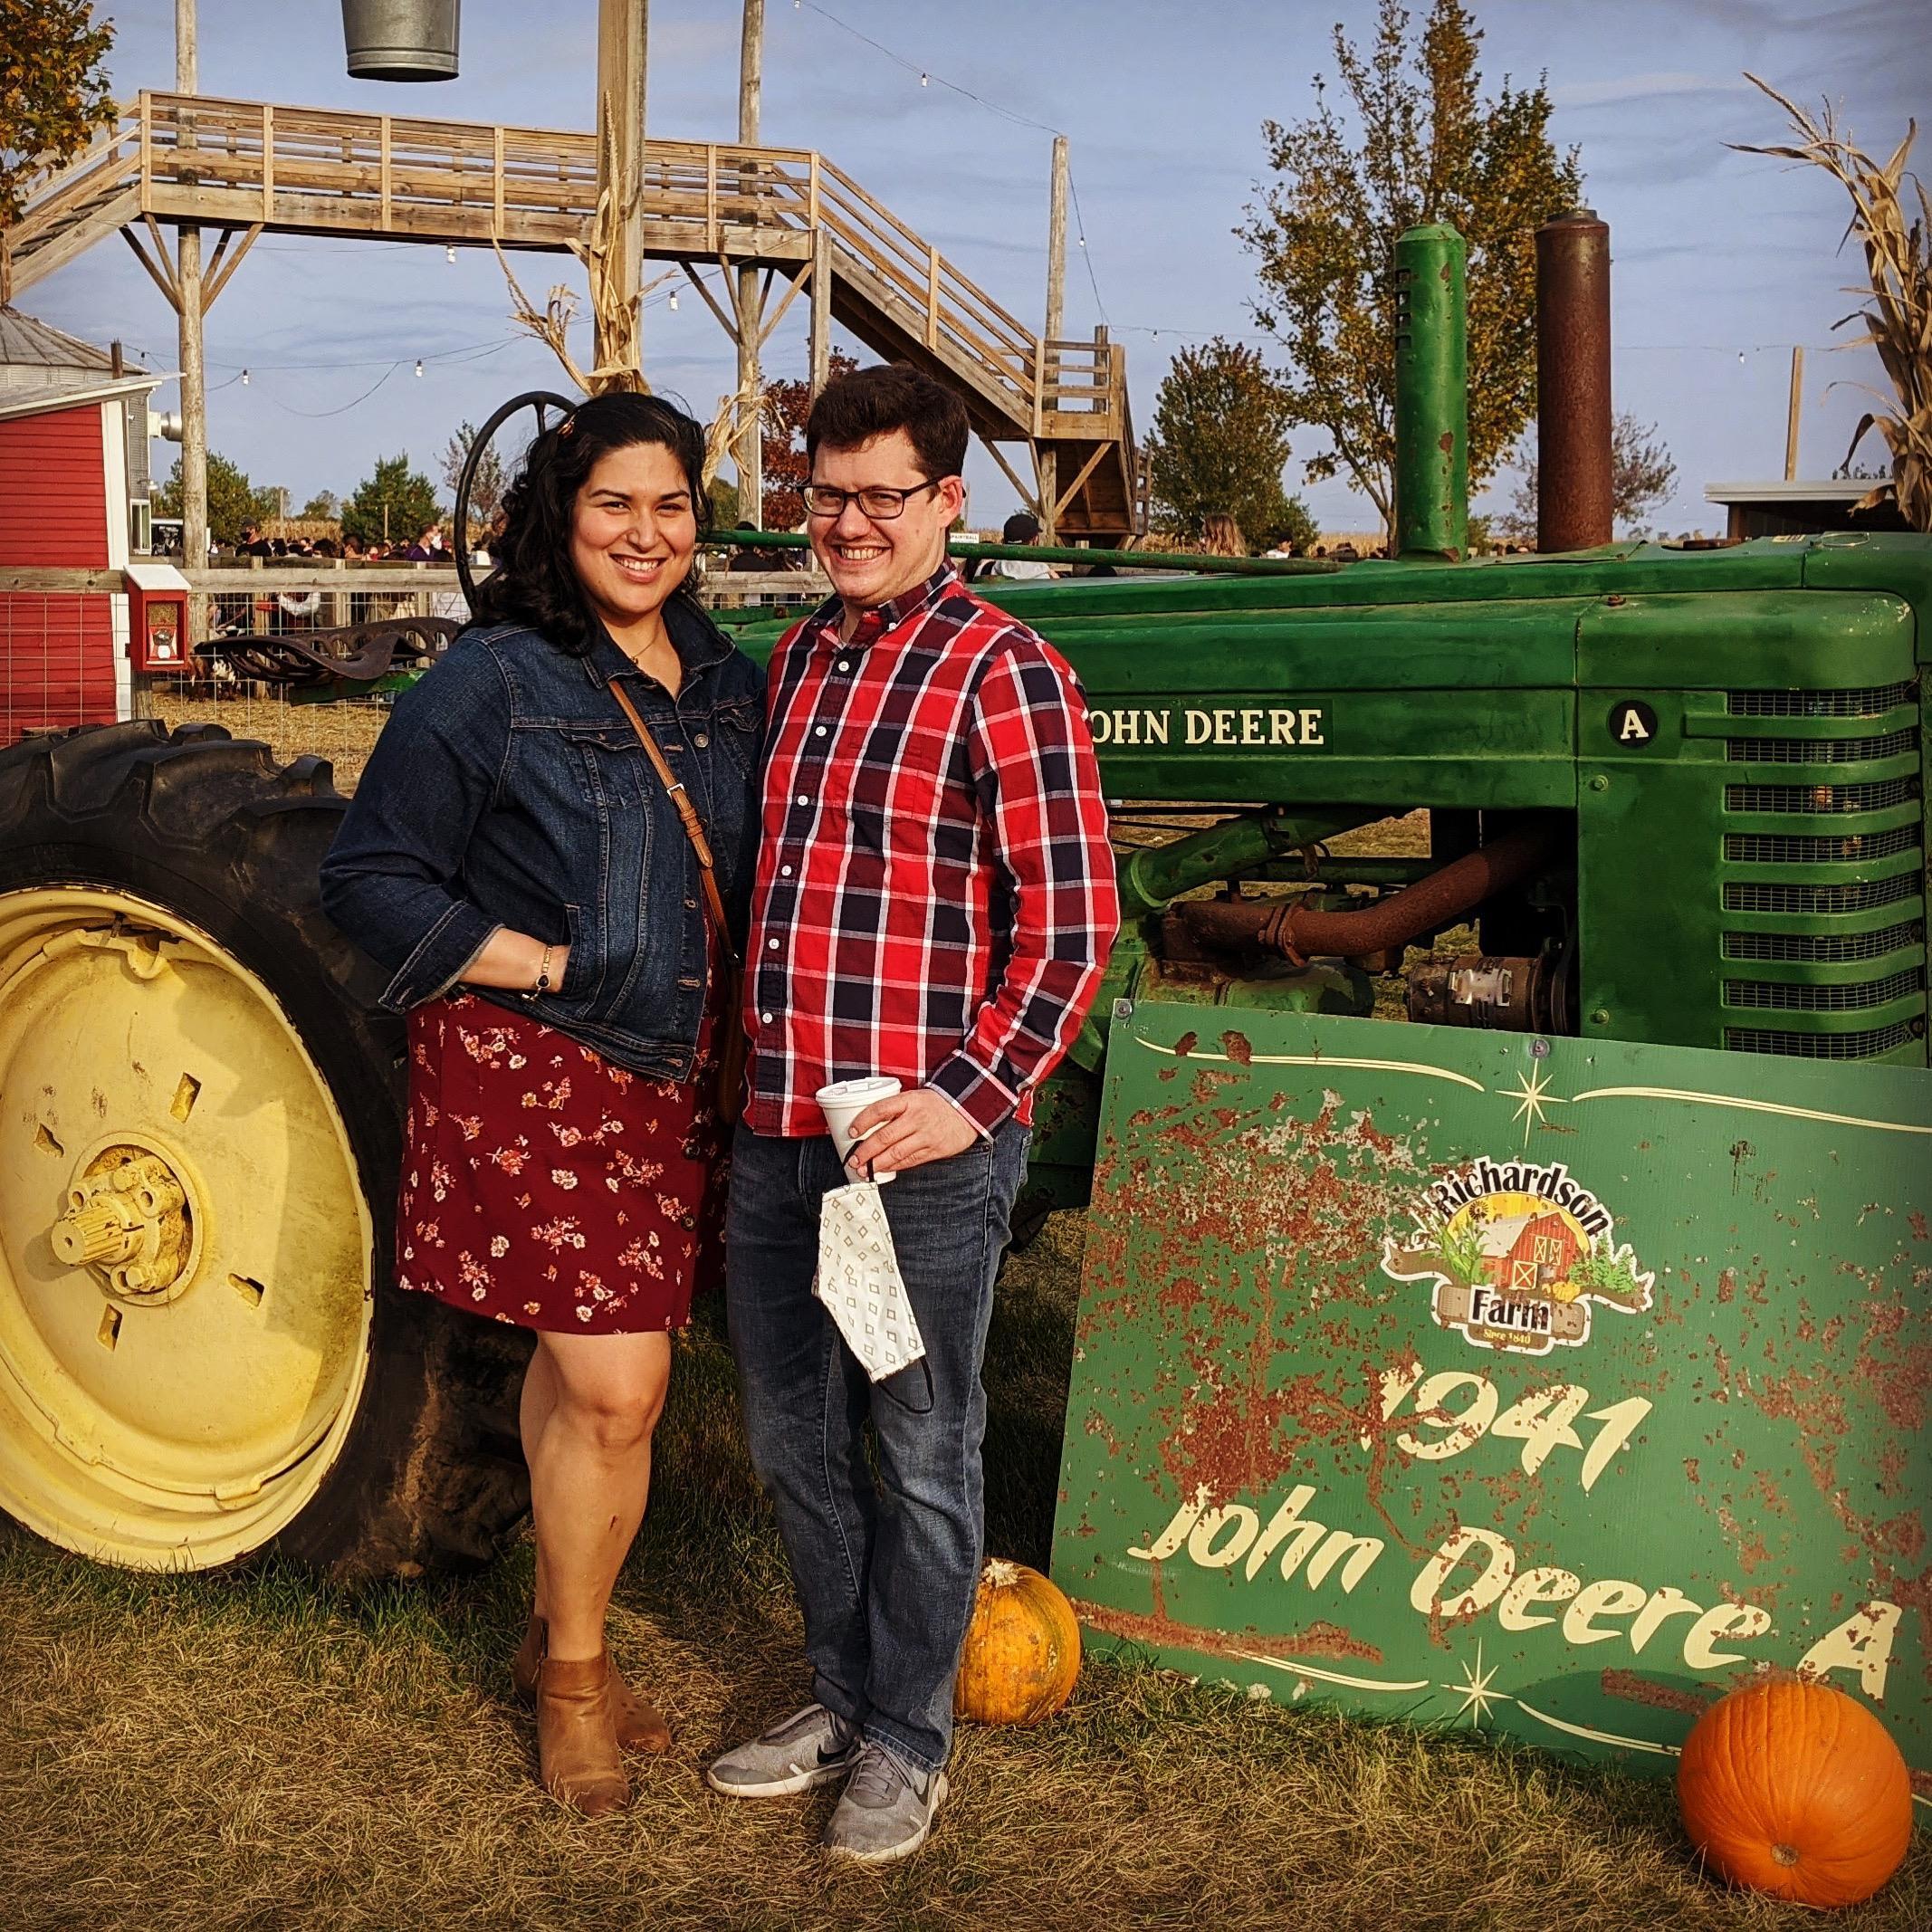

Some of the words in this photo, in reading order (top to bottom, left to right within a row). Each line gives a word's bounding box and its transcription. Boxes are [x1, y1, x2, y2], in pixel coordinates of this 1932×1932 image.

[1089, 710, 1170, 744] OHN
[1184, 709, 1325, 745] DEERE
[1620, 710, 1650, 740] A
[1429, 1161, 1610, 1237] Richardson
[1472, 1288, 1549, 1331] Farm
[1360, 1362, 1653, 1492] 1941
[1127, 1478, 1384, 1593] John
[1410, 1525, 1772, 1669] Deere
[1796, 1601, 1902, 1700] A
